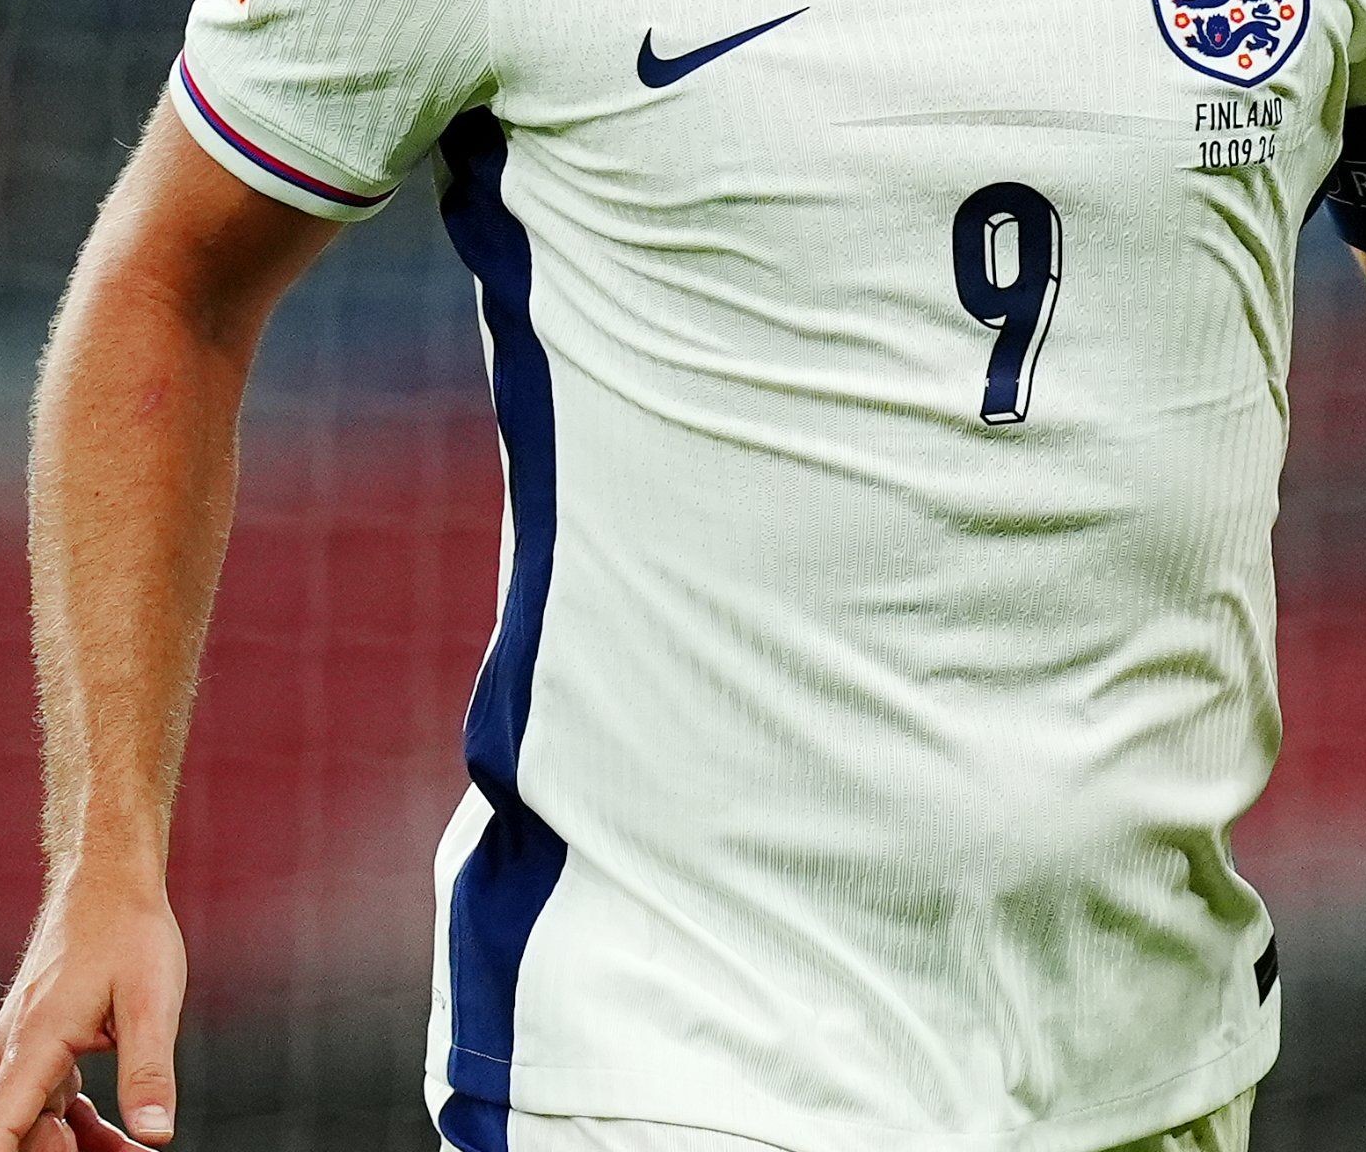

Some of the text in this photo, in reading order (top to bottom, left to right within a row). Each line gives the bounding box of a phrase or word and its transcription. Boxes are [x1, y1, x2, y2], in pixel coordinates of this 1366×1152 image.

[1195, 97, 1283, 132] FINLAND
[1199, 134, 1275, 169] 10.09.24
[952, 181, 1063, 426] 9
